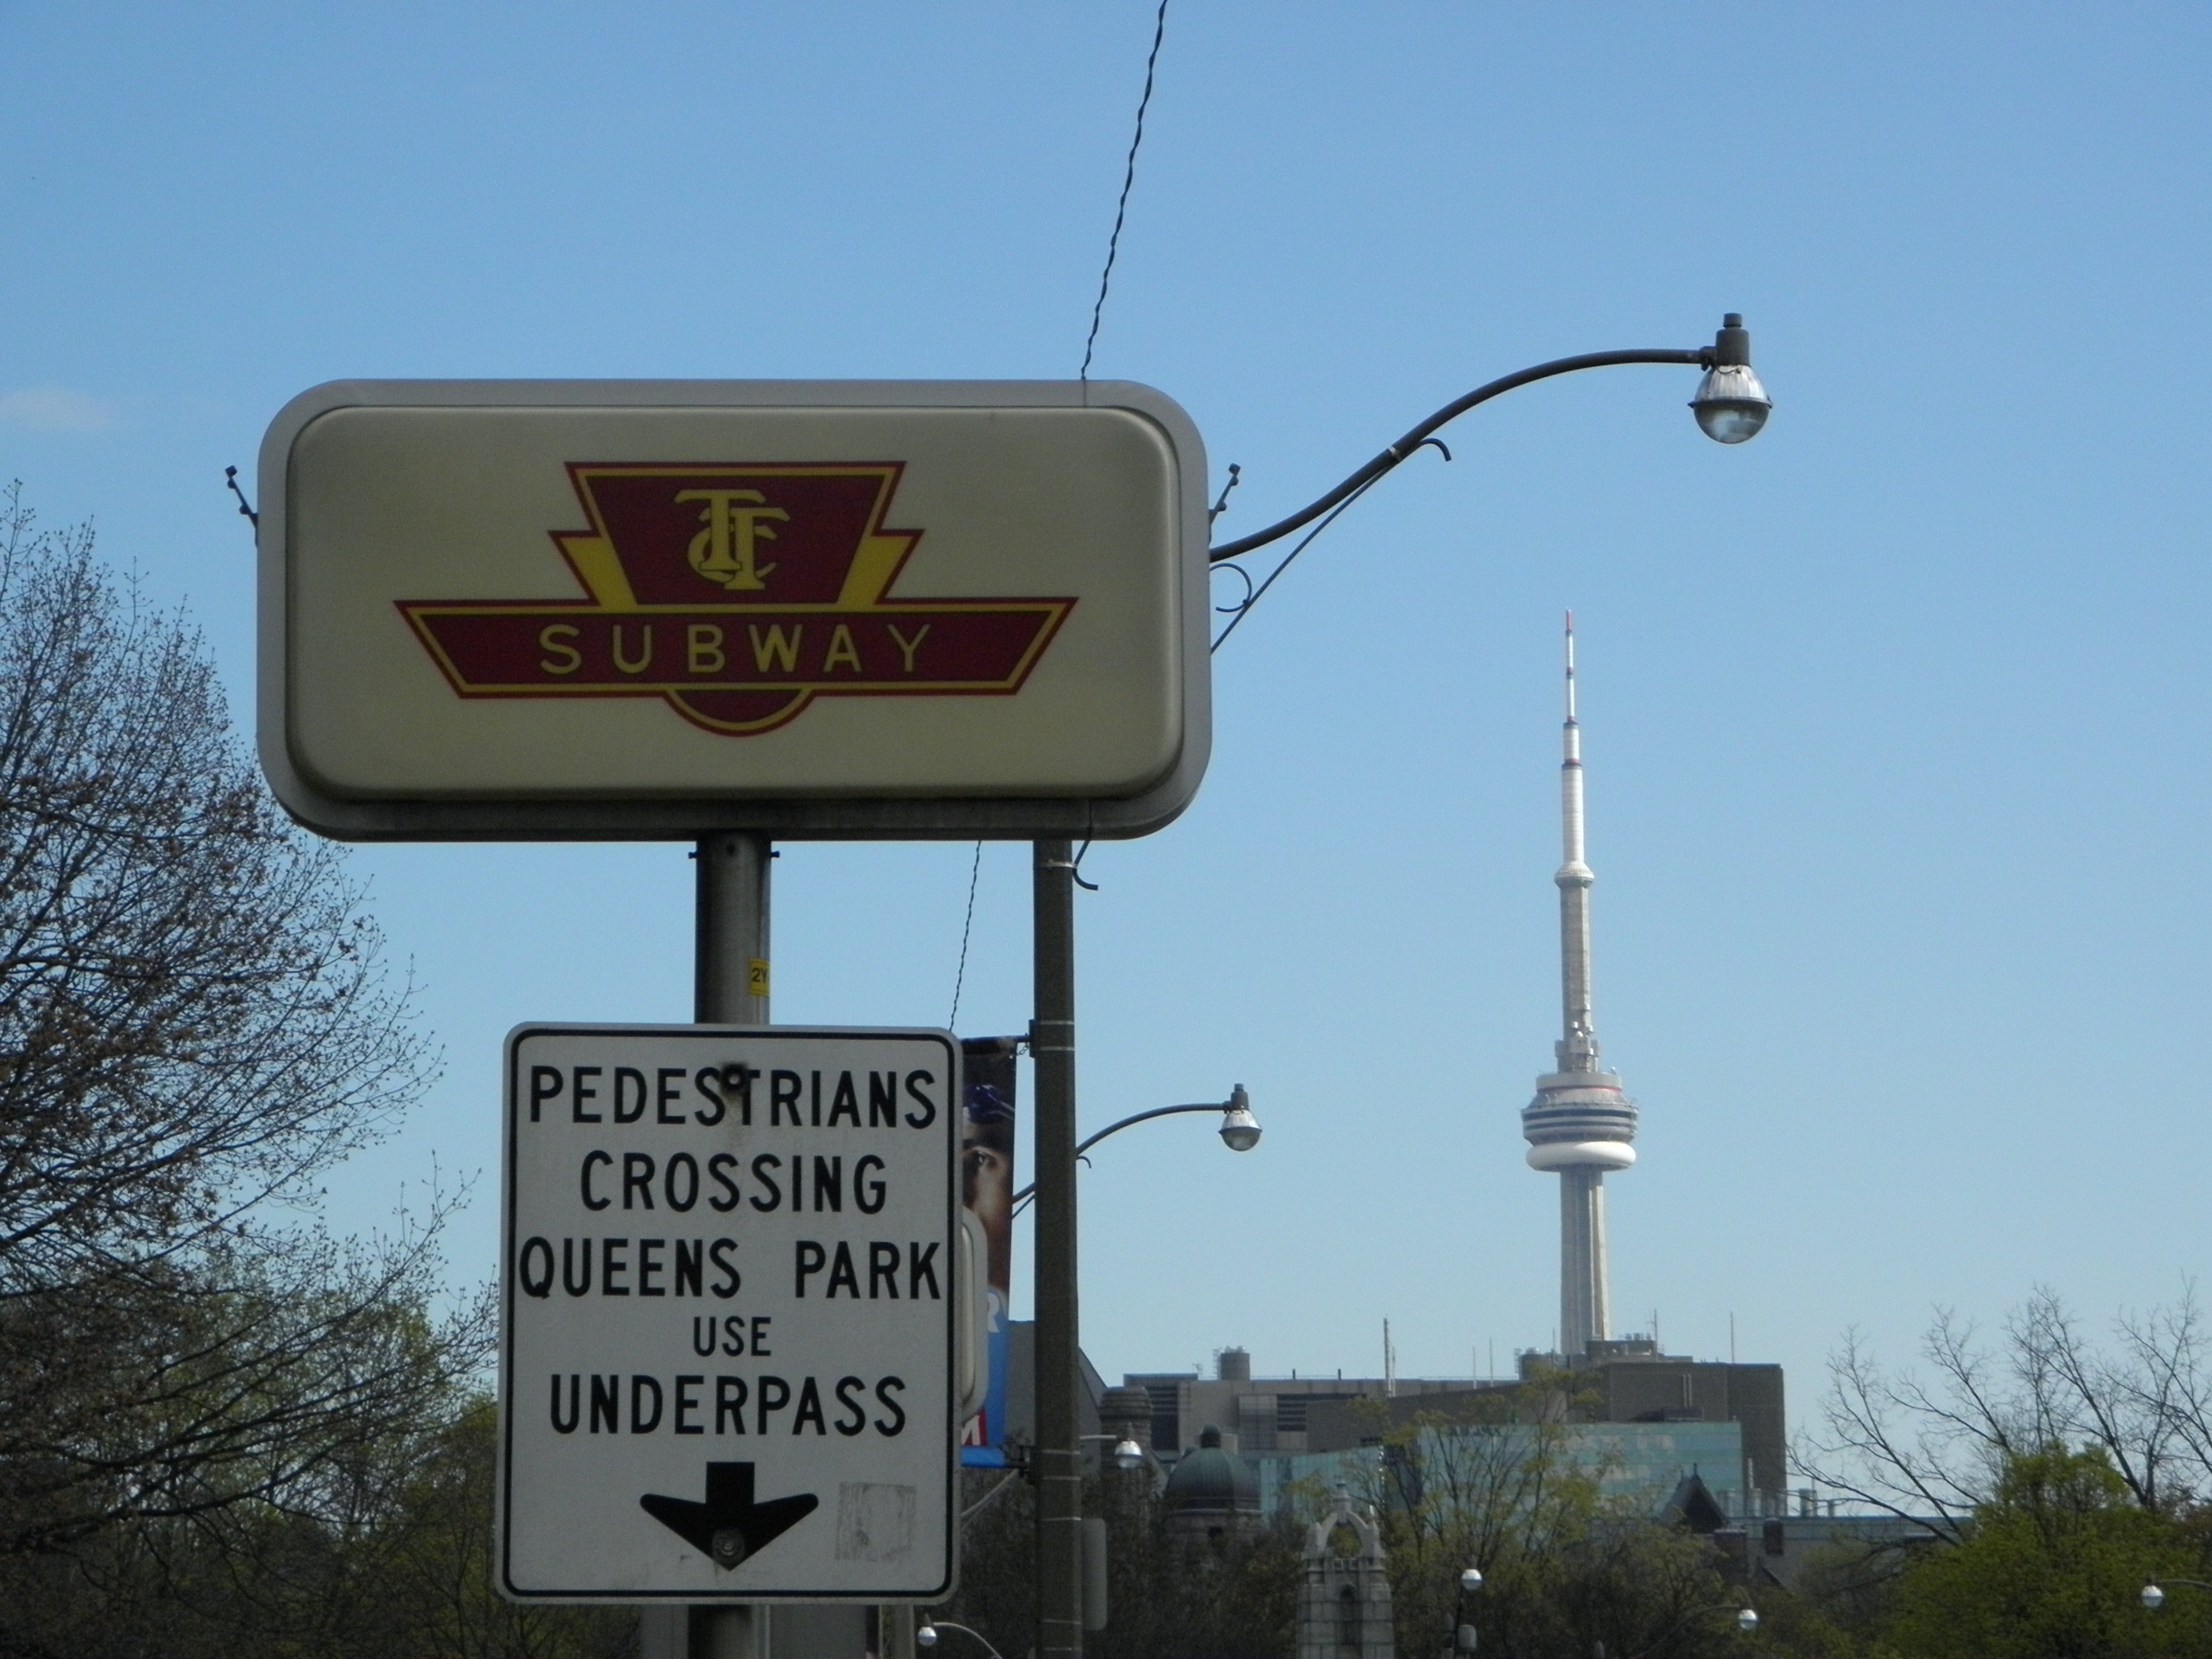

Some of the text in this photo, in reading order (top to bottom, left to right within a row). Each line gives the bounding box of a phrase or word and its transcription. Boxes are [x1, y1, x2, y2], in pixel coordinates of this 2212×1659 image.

[540, 624, 930, 675] SUBWAY
[531, 1065, 936, 1129] PEDESTRIANS
[581, 1149, 887, 1215] CROSSING
[520, 1236, 941, 1300] QUEENS PARK
[693, 1316, 772, 1357] USE
[550, 1374, 906, 1437] UNDERPASS
